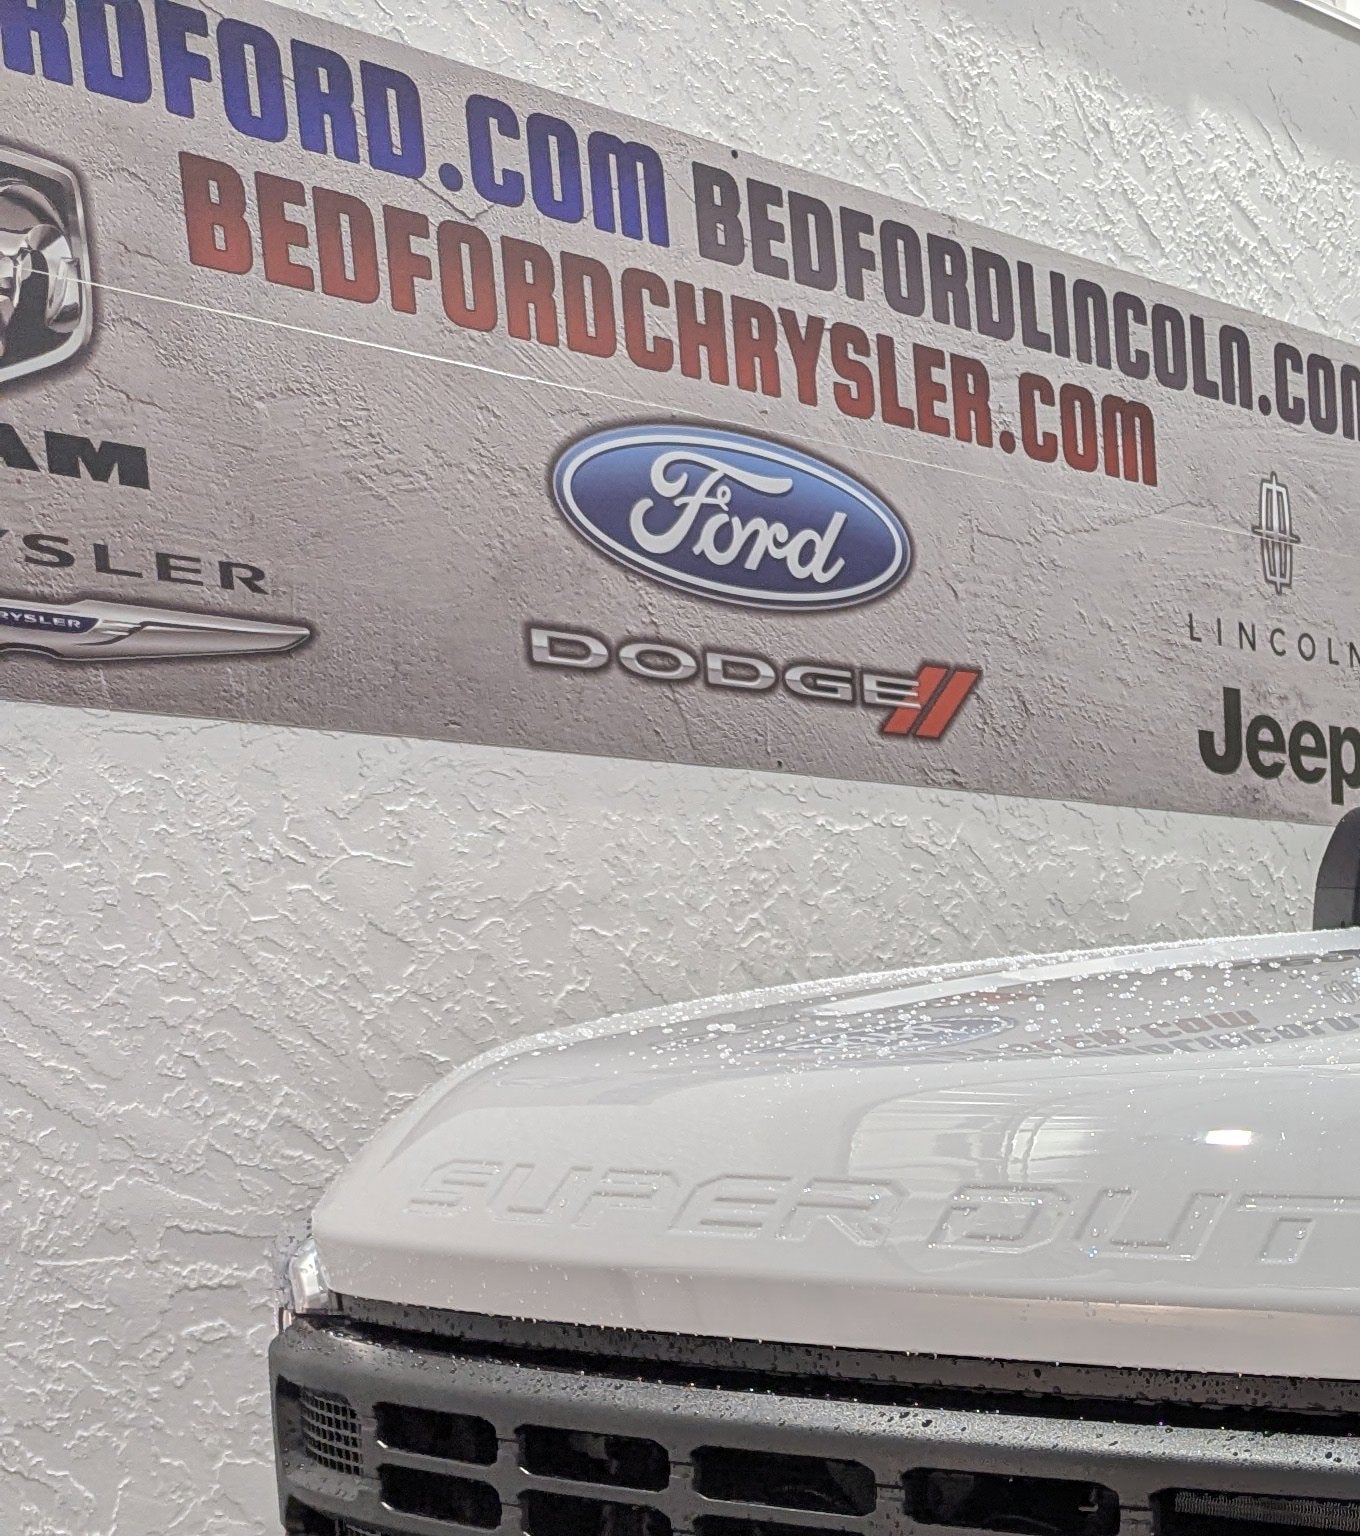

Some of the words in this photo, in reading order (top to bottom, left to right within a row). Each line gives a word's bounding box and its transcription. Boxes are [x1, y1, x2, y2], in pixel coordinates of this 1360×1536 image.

[178, 151, 1157, 486] BEDFORDCHRYSLER.COM
[630, 449, 847, 584] Ford
[0, 529, 270, 595] SLER
[530, 627, 922, 710] DODGE
[404, 1158, 908, 1248] SUPER
